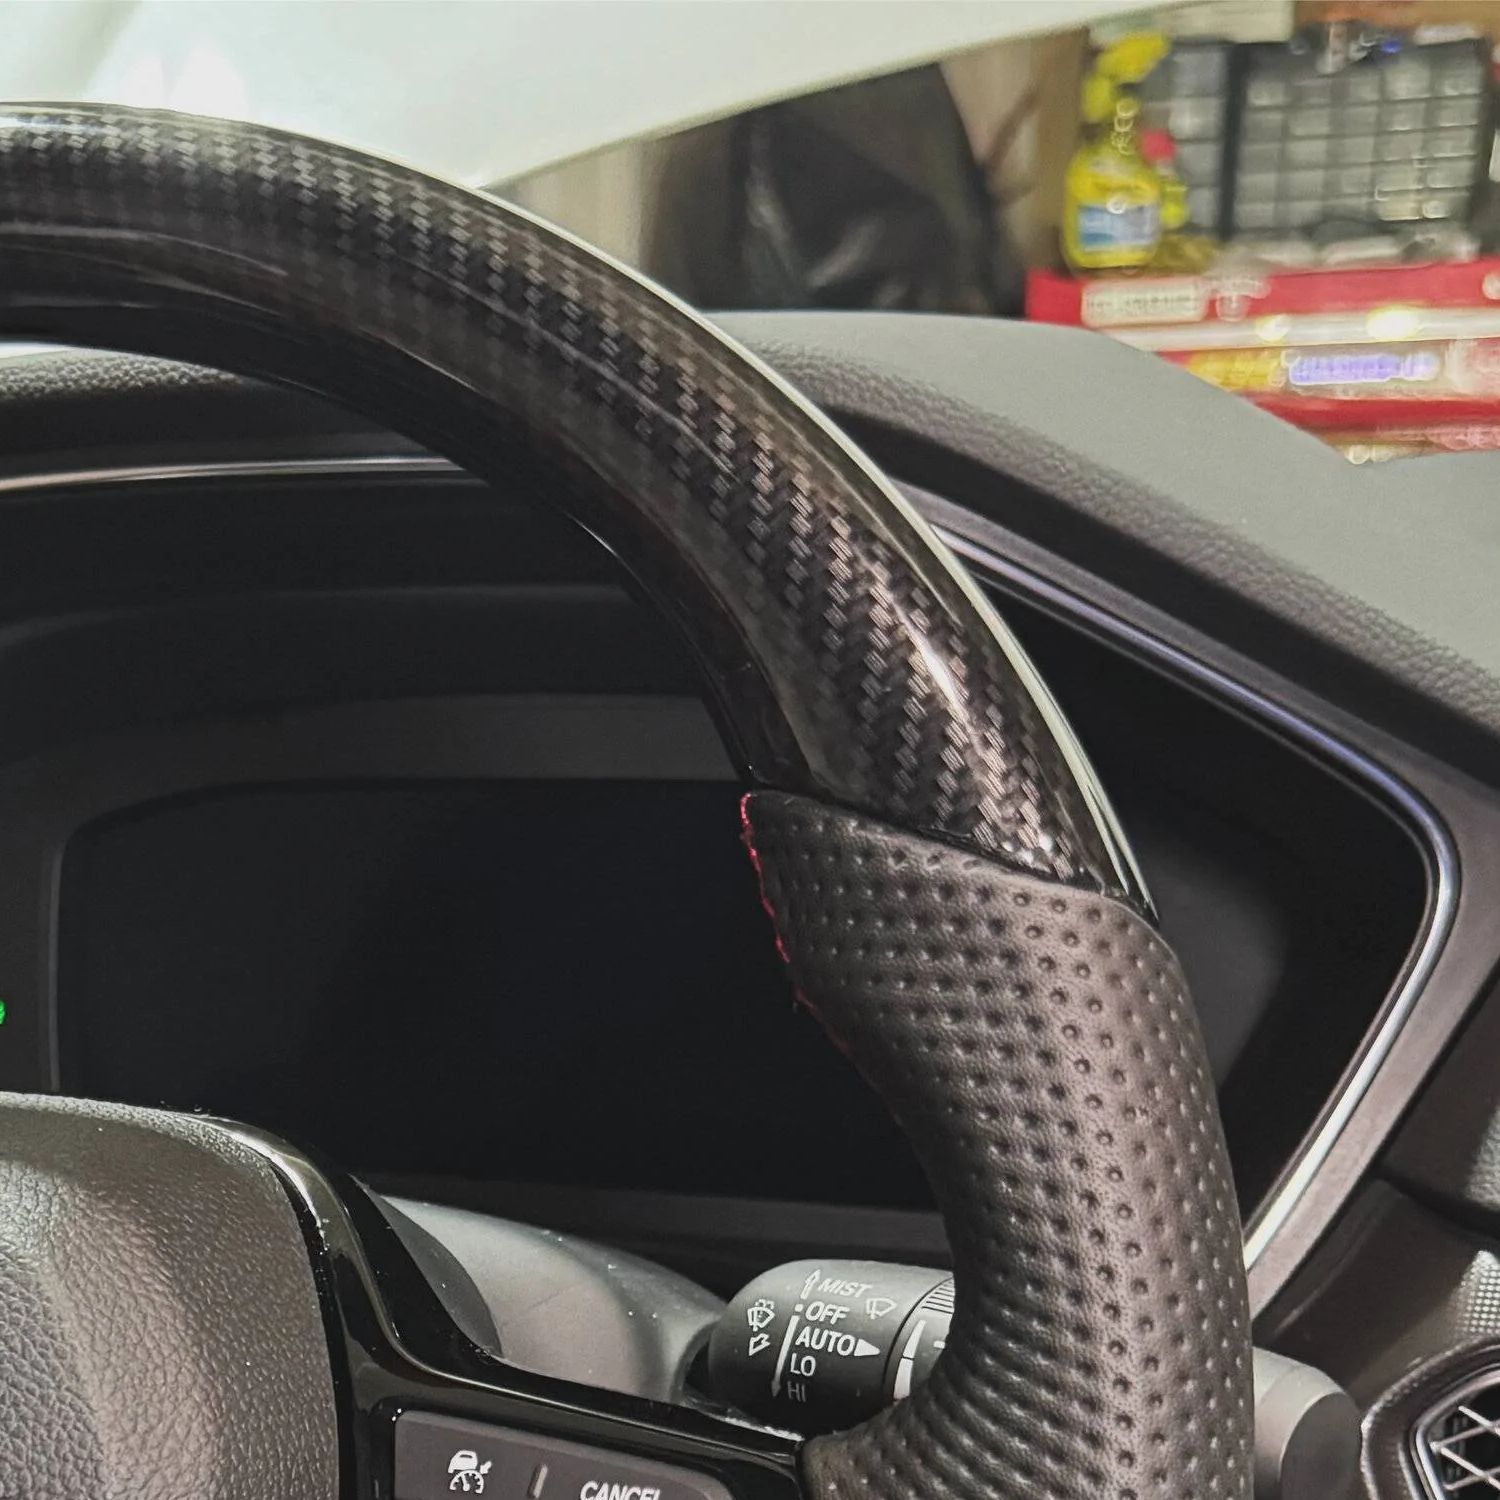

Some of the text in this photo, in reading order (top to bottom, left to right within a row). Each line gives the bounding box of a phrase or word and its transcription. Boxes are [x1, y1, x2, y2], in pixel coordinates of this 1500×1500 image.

[817, 1277, 874, 1298] MIST
[805, 1301, 851, 1326] OFF
[795, 1326, 856, 1357] AUTO
[790, 1352, 817, 1377] LO
[786, 1381, 808, 1402] HI
